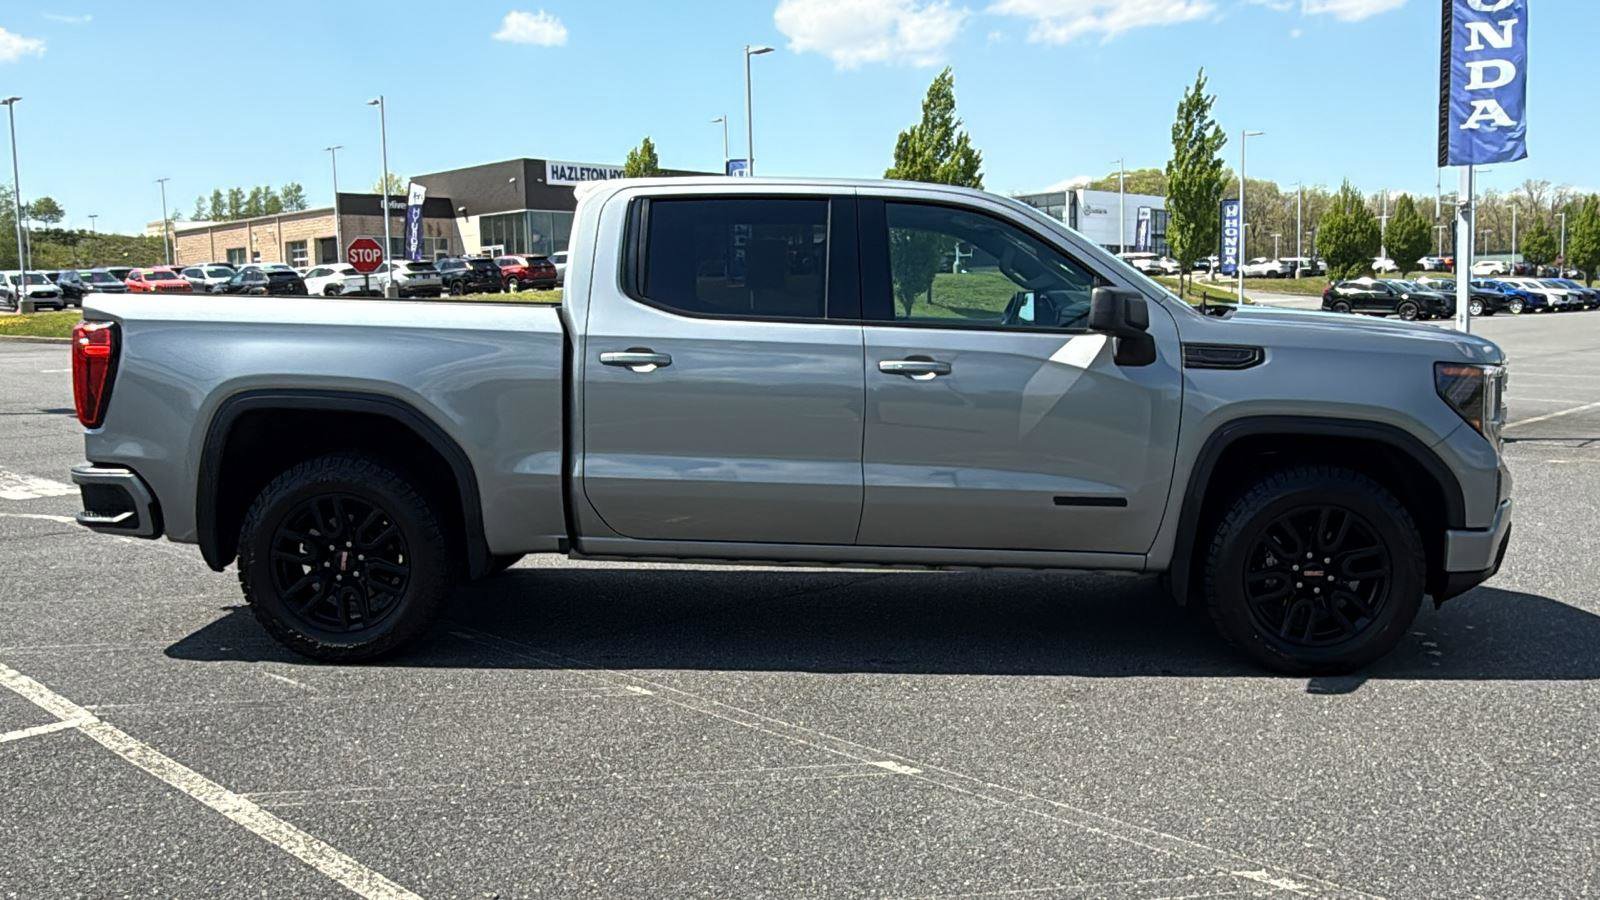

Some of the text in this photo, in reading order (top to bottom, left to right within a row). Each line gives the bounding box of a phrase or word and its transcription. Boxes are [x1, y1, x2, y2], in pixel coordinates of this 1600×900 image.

[551, 164, 608, 181] HAZLETON
[1224, 218, 1238, 265] HONDA
[349, 248, 381, 263] STOP
